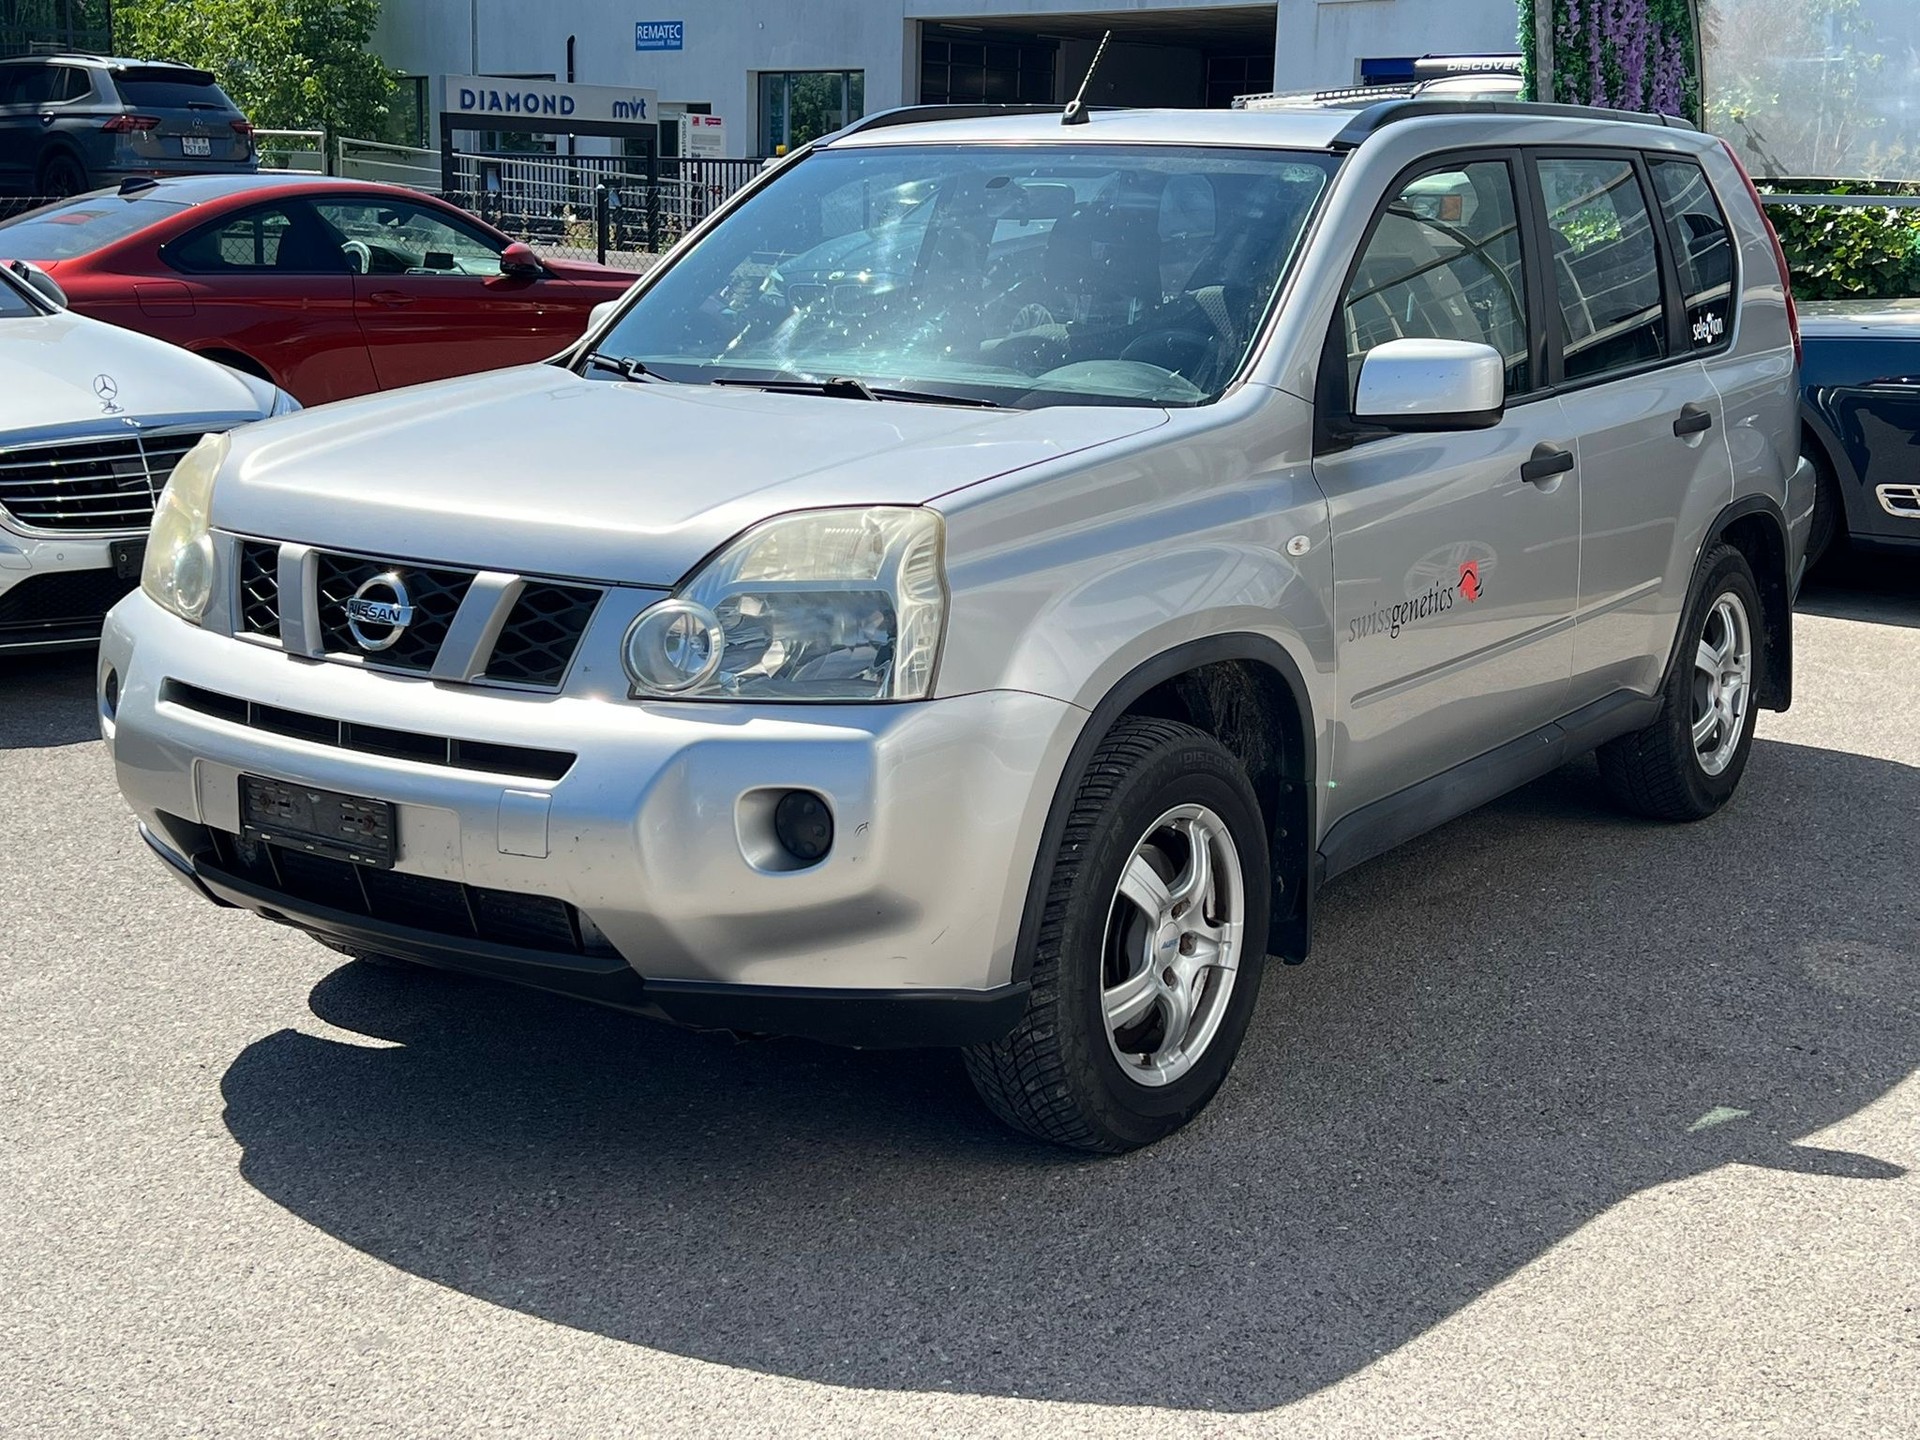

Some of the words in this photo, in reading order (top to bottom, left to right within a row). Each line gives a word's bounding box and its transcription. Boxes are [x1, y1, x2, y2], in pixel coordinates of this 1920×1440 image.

[637, 25, 681, 39] REMATEC
[1447, 61, 1522, 71] DISCOVER
[460, 89, 575, 115] DIAMOND
[612, 96, 647, 119] mvt
[349, 603, 401, 622] NISSAN
[1349, 580, 1454, 642] swissgenetics
